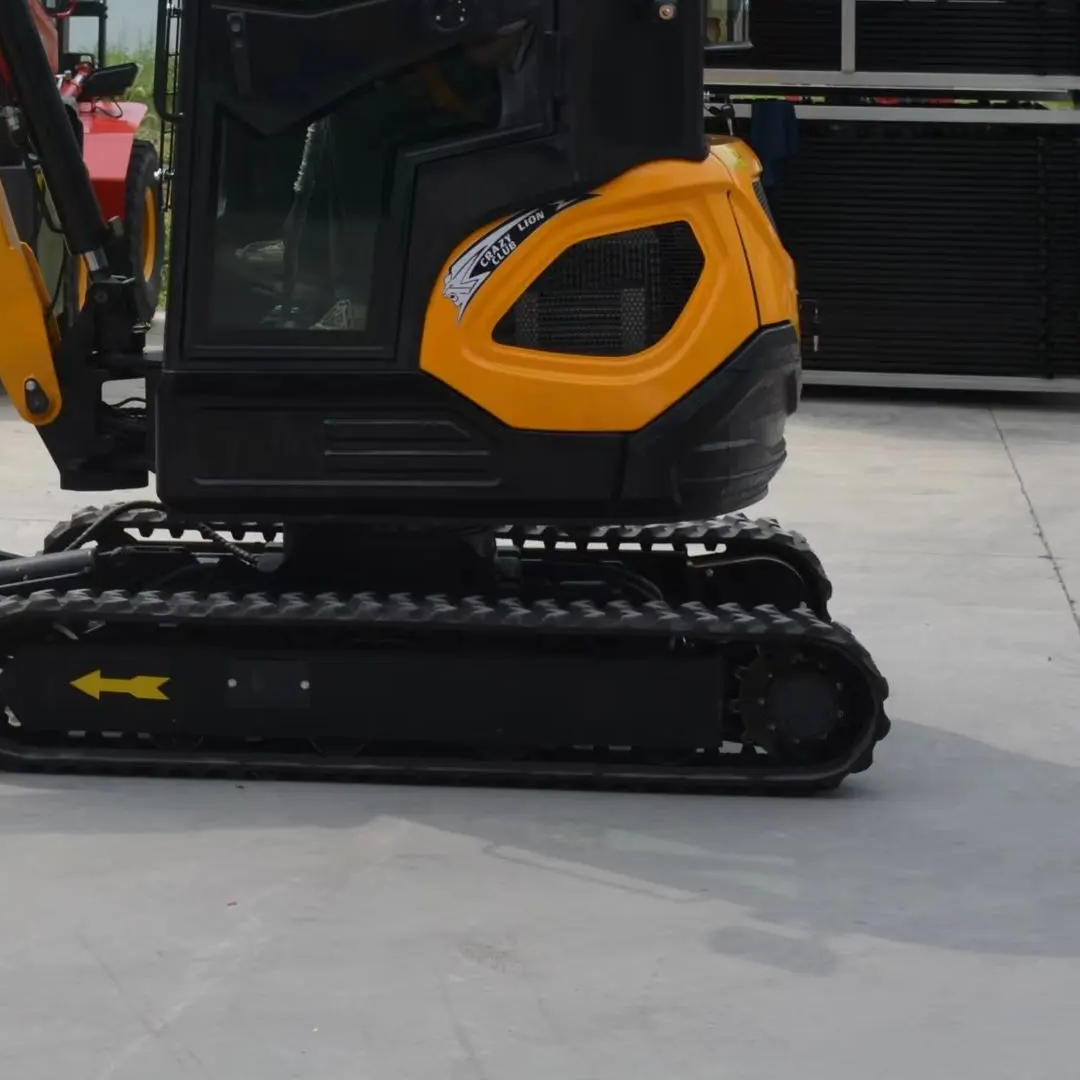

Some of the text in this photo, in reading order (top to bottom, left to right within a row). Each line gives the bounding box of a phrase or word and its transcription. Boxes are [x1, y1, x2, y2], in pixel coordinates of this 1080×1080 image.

[518, 210, 545, 232] LION
[480, 233, 512, 267] CRAZY
[491, 240, 517, 266] CLUB
